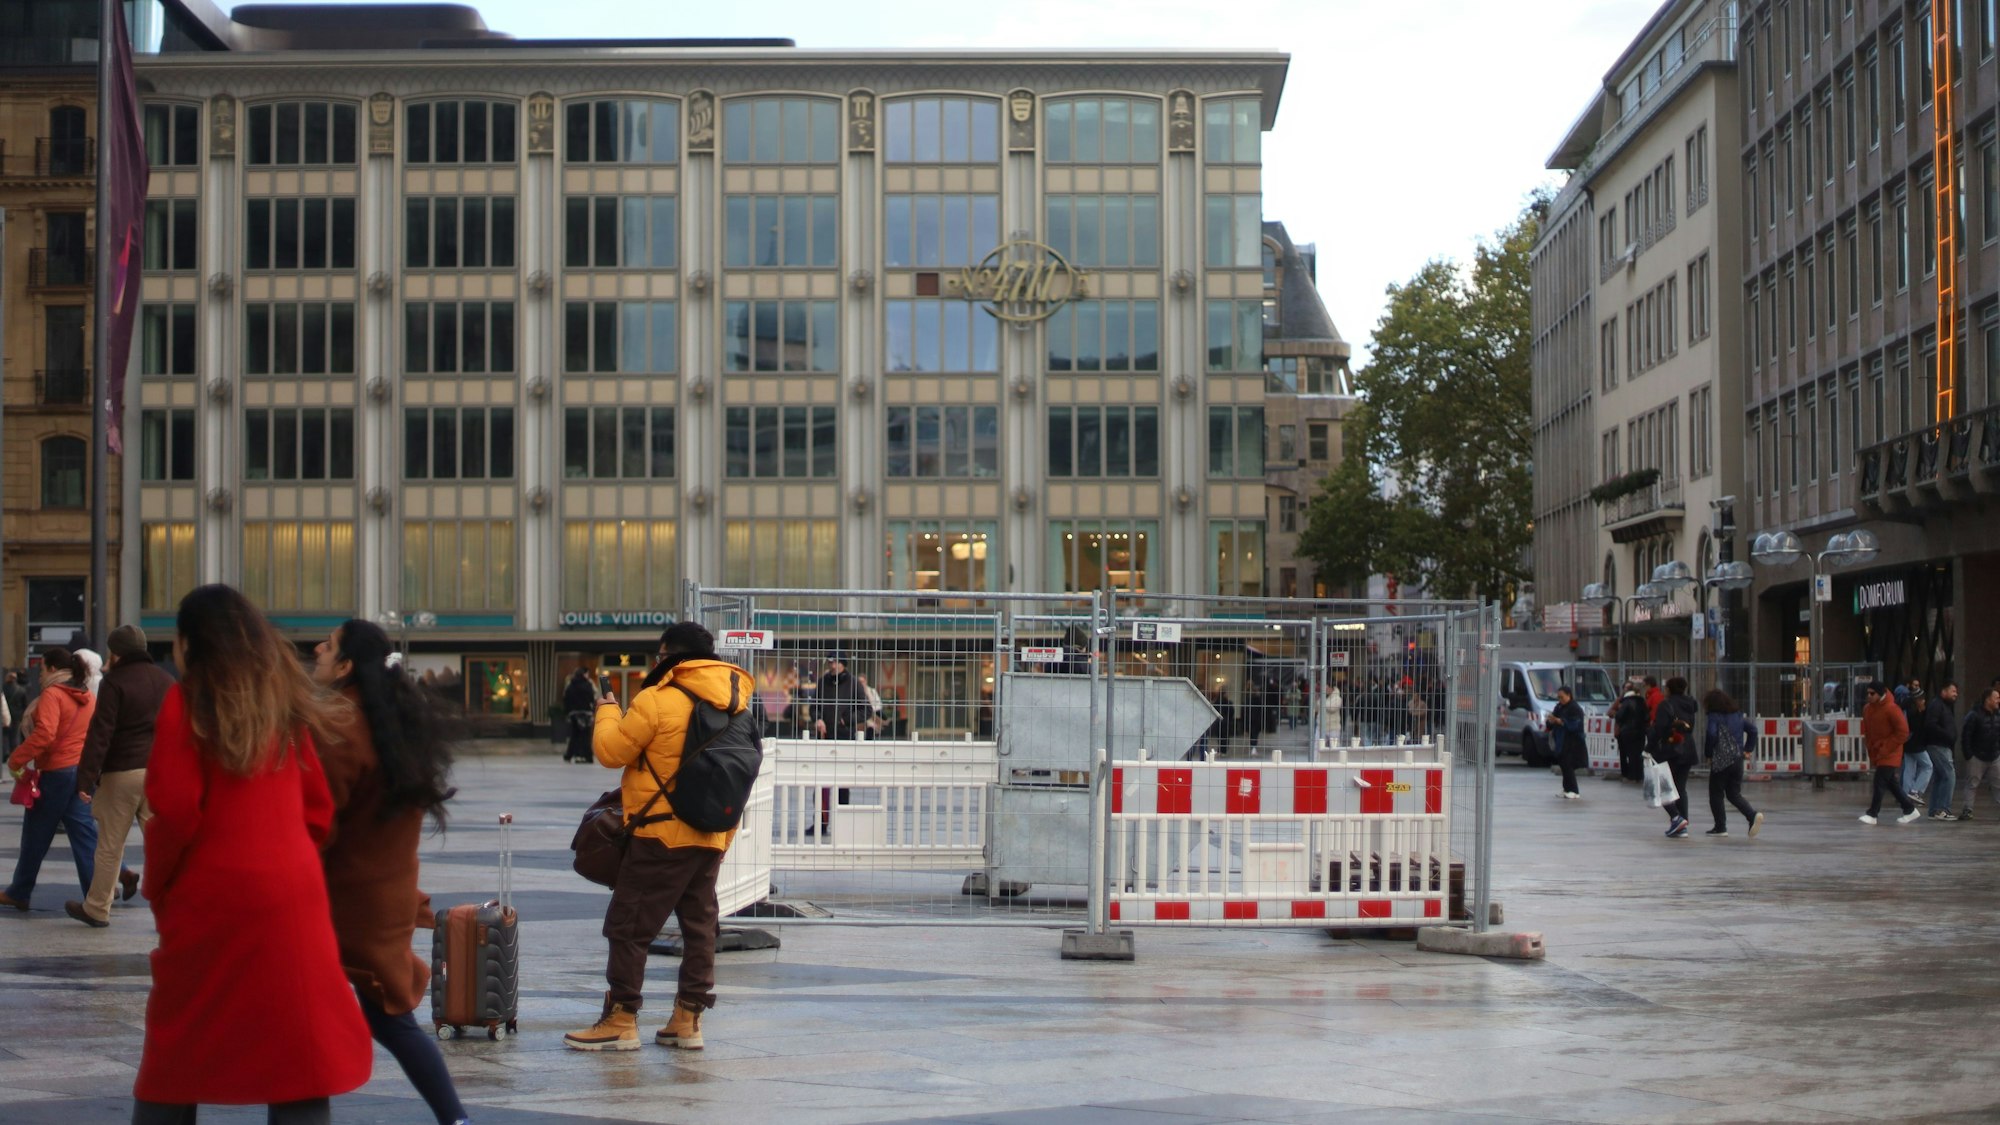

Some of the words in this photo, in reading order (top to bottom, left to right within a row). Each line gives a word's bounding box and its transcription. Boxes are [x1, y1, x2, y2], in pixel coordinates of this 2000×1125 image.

[1859, 579, 1905, 609] DOMFORUM
[559, 611, 602, 625] LOUIS
[611, 611, 677, 625] VUITTON
[726, 631, 763, 644] müba
